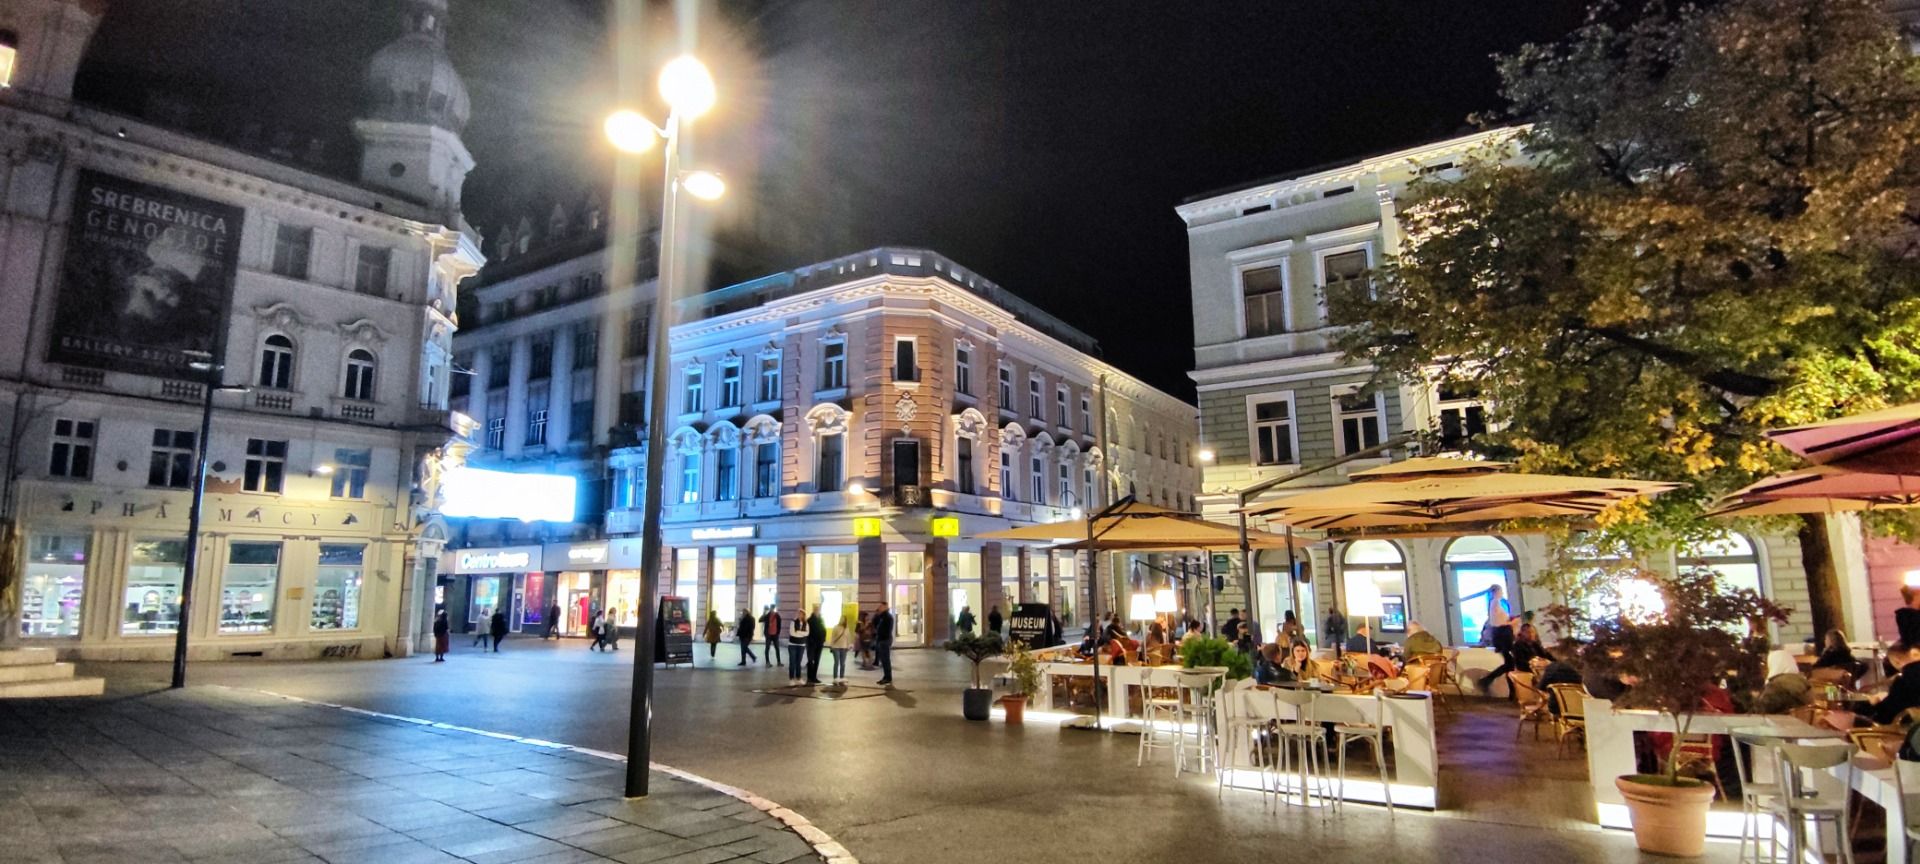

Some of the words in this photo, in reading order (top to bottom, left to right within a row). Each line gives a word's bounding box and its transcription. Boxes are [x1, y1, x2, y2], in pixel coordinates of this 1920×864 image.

[90, 187, 227, 234] SREBRENICA
[86, 209, 226, 255] GENOCIDE
[61, 336, 134, 357] GALLERY
[1011, 617, 1046, 629] MUSEUM
